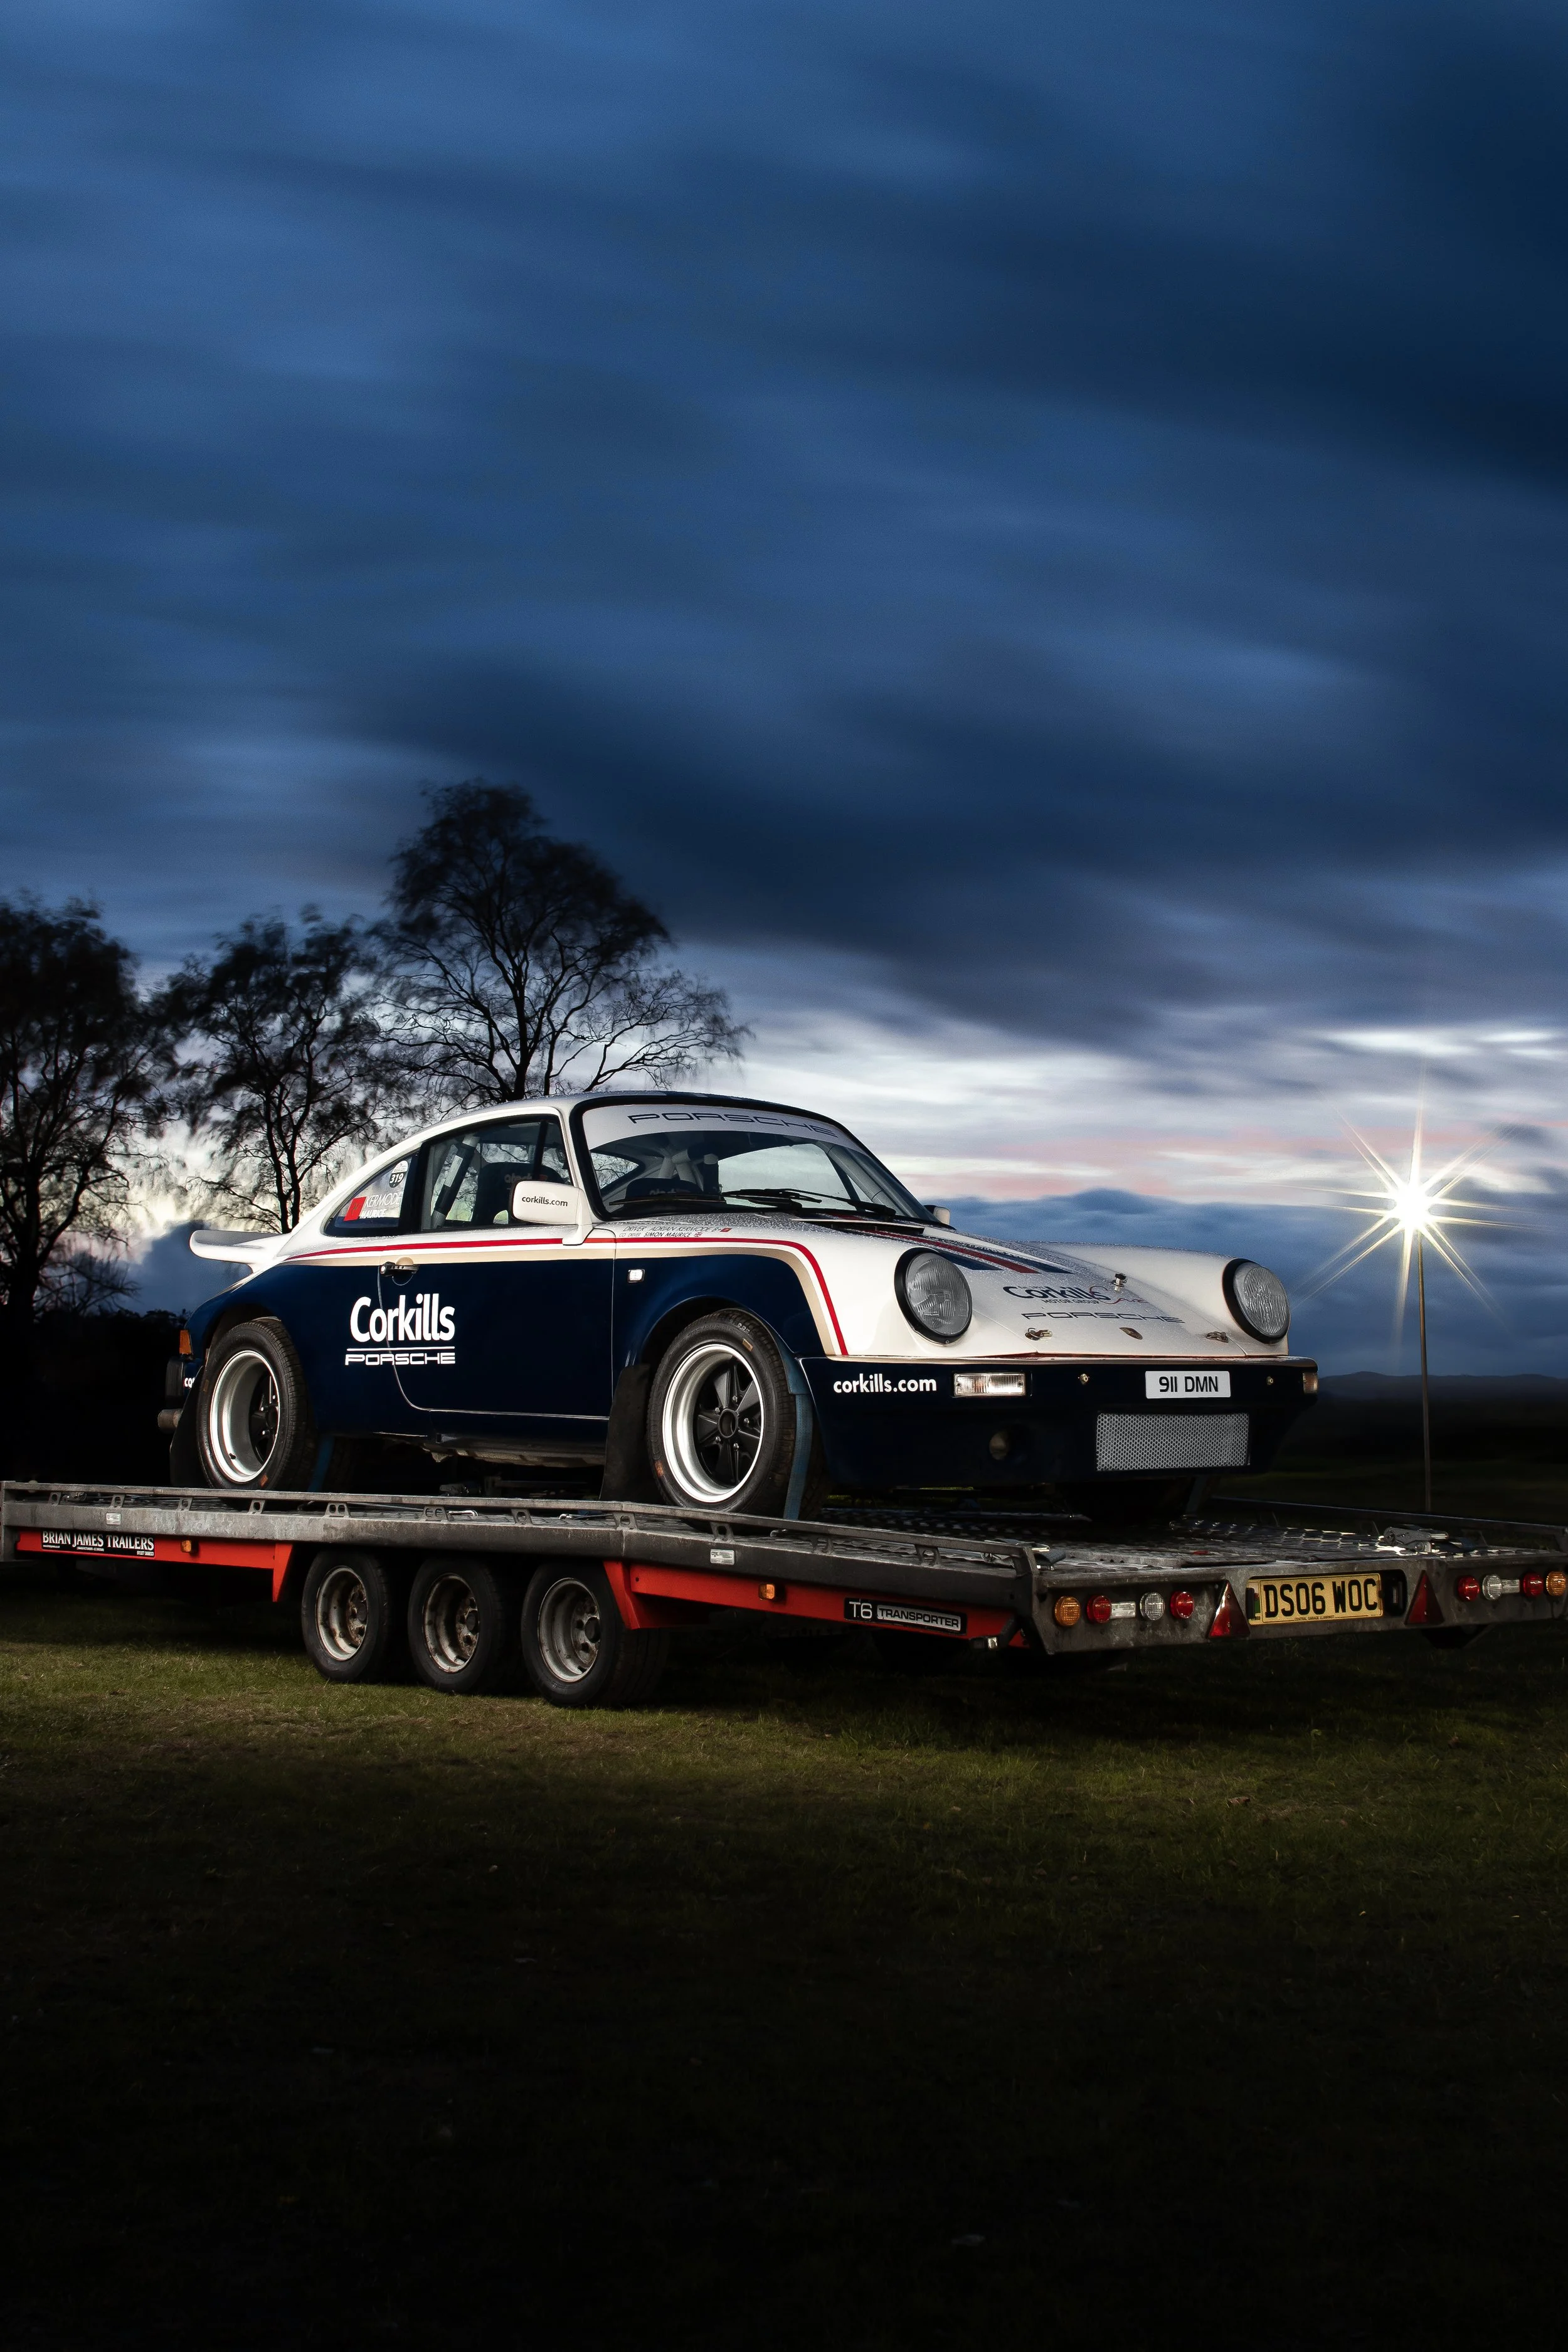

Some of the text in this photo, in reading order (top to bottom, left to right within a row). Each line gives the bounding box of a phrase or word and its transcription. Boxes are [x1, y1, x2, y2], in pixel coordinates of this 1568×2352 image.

[627, 1113, 838, 1138] PORSCHE
[389, 1173, 404, 1184] 319
[366, 1192, 403, 1208] KERMODE
[522, 1196, 568, 1207] corkills.com
[359, 1208, 388, 1219] MAURICE
[1002, 1286, 1111, 1301] Corkills
[350, 1293, 456, 1343] Corkills
[1021, 1311, 1186, 1324] PORSCHE
[344, 1352, 456, 1366] PORSCHE
[833, 1373, 937, 1394] corkills.com
[1158, 1376, 1219, 1392] 911 DMN
[43, 1530, 154, 1551] BRIAN JAMES TRAILERS
[1263, 1577, 1378, 1618] DS06 WOC
[849, 1601, 960, 1628] T6 TRANSPORTER
